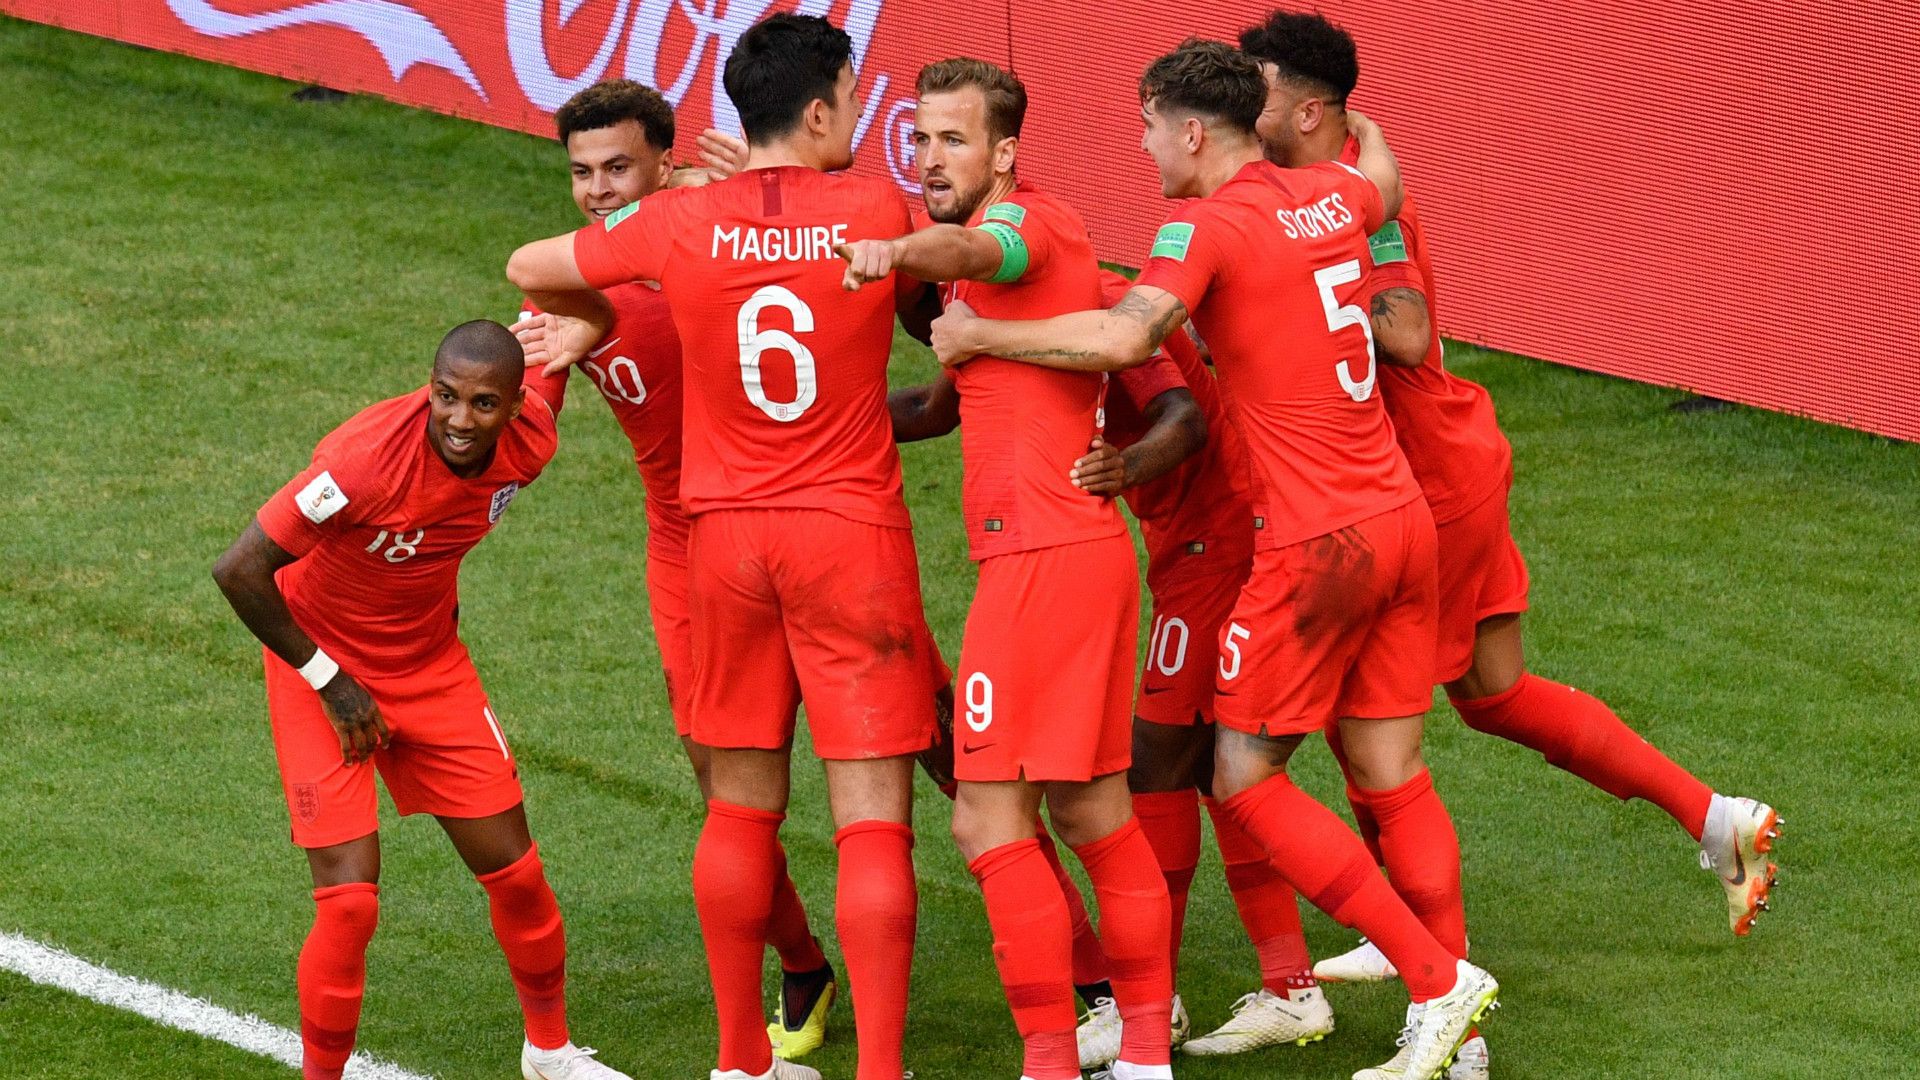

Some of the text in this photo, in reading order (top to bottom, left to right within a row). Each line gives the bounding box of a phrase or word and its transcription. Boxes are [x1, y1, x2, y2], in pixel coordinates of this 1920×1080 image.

[711, 223, 848, 262] MAGUIRE
[1276, 191, 1353, 240] STONES
[737, 285, 818, 423] 6
[1313, 258, 1377, 403] 5
[584, 355, 647, 405] 20
[365, 528, 425, 563] 18
[1146, 613, 1190, 677] 10
[1219, 622, 1251, 681] 5
[965, 671, 994, 733] 9
